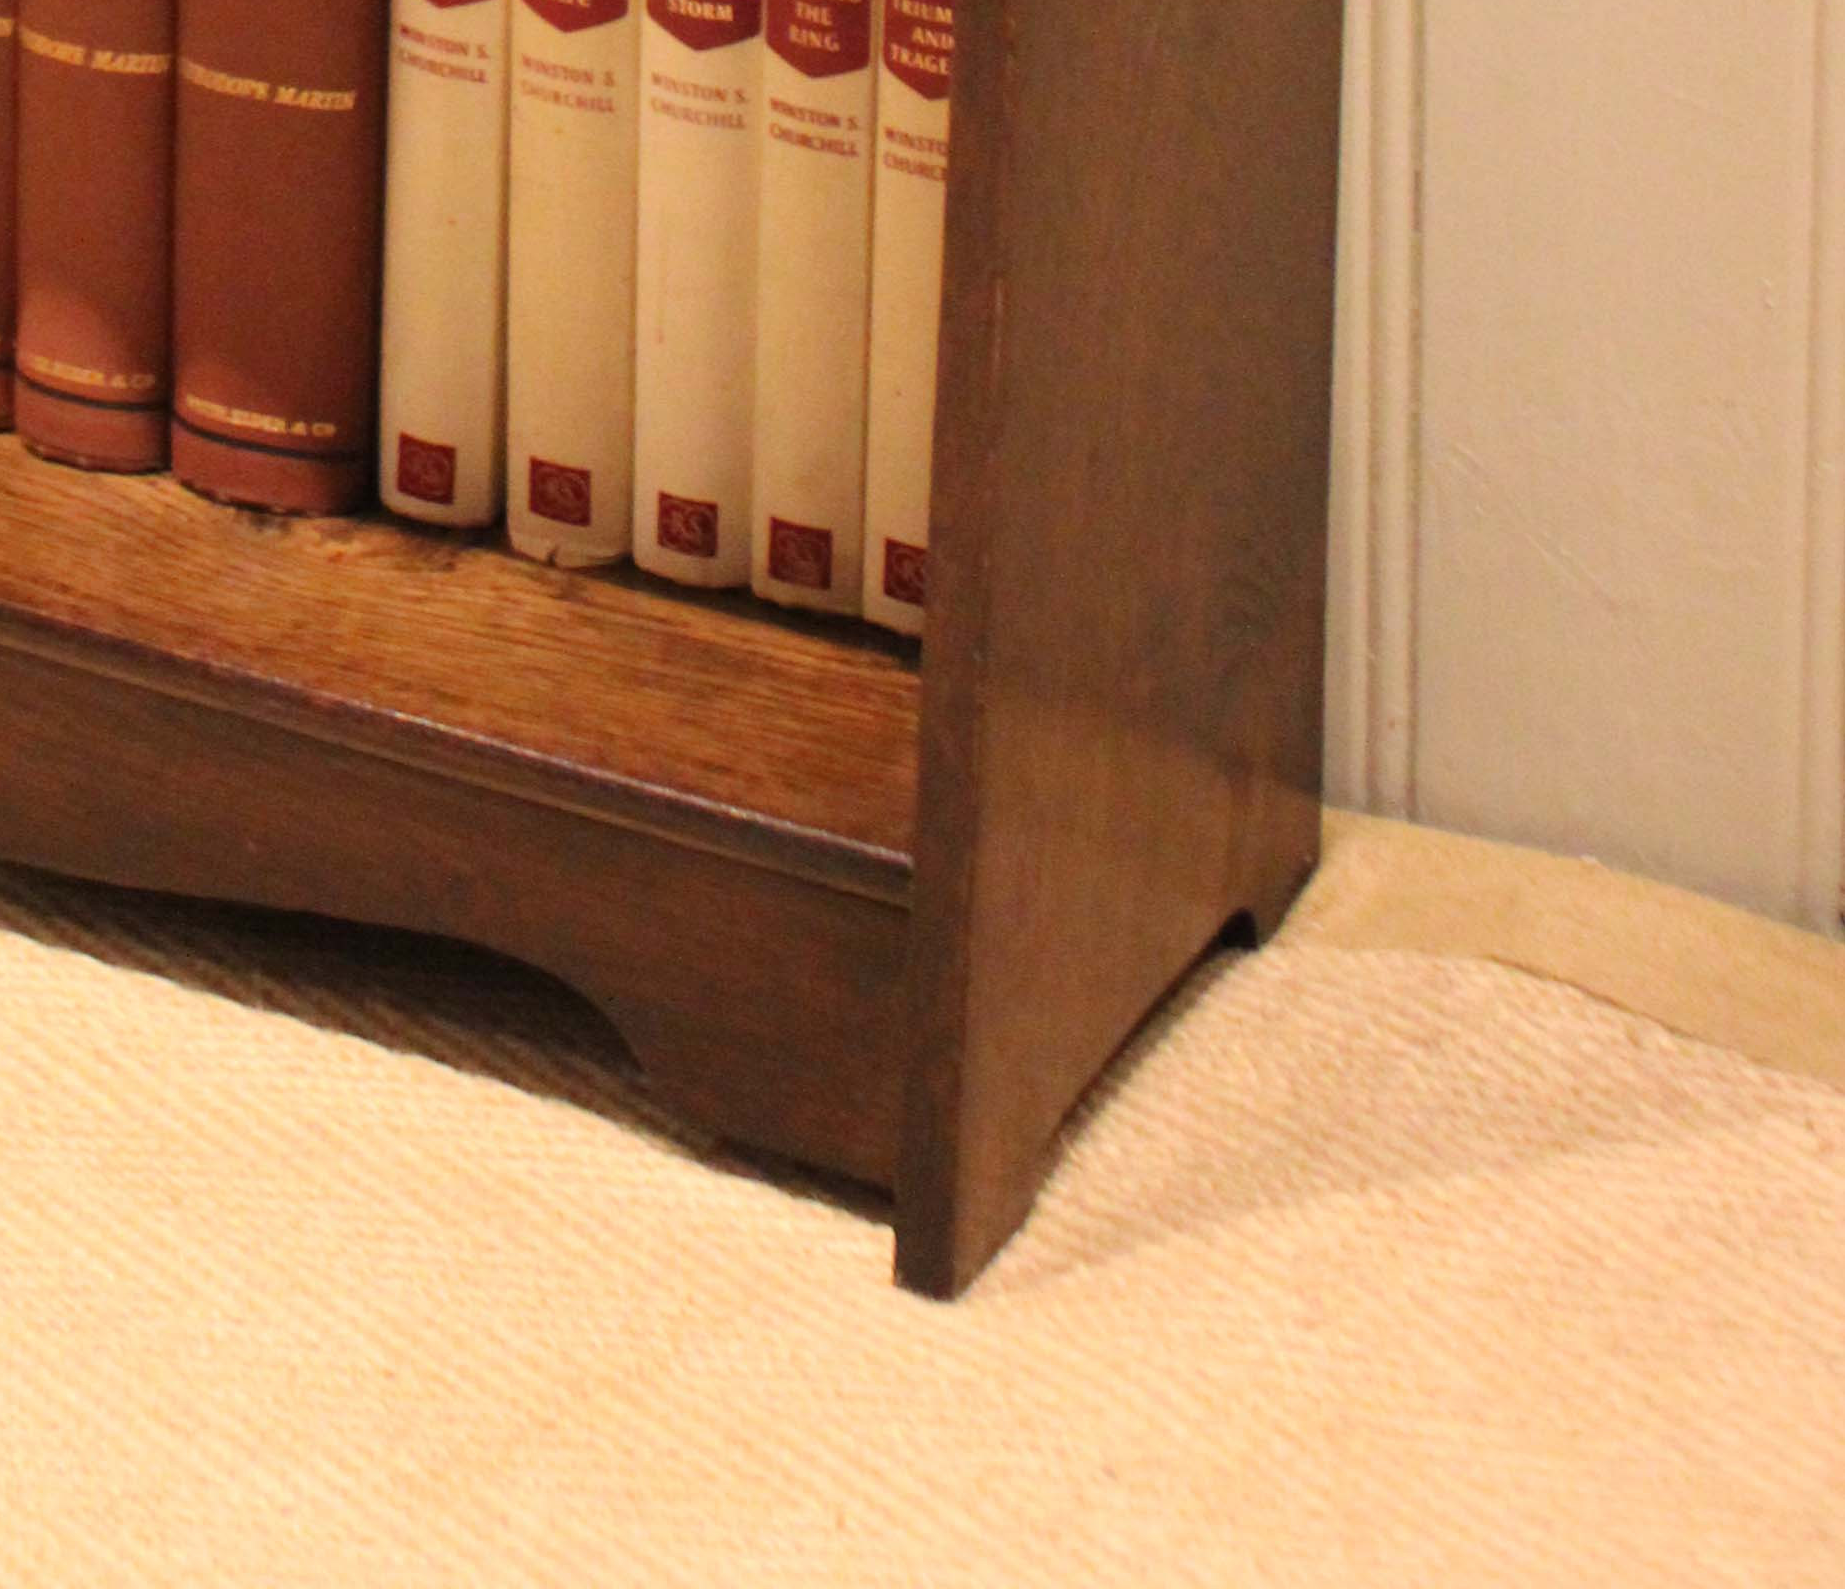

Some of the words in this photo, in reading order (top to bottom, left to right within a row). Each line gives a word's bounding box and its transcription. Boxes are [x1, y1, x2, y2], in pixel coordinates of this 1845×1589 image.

[793, 1, 835, 28] THE
[787, 23, 841, 53] RING
[649, 71, 727, 103] WINSTON
[650, 95, 747, 131] CHURCHILL
[769, 122, 860, 159] CHURCHILL
